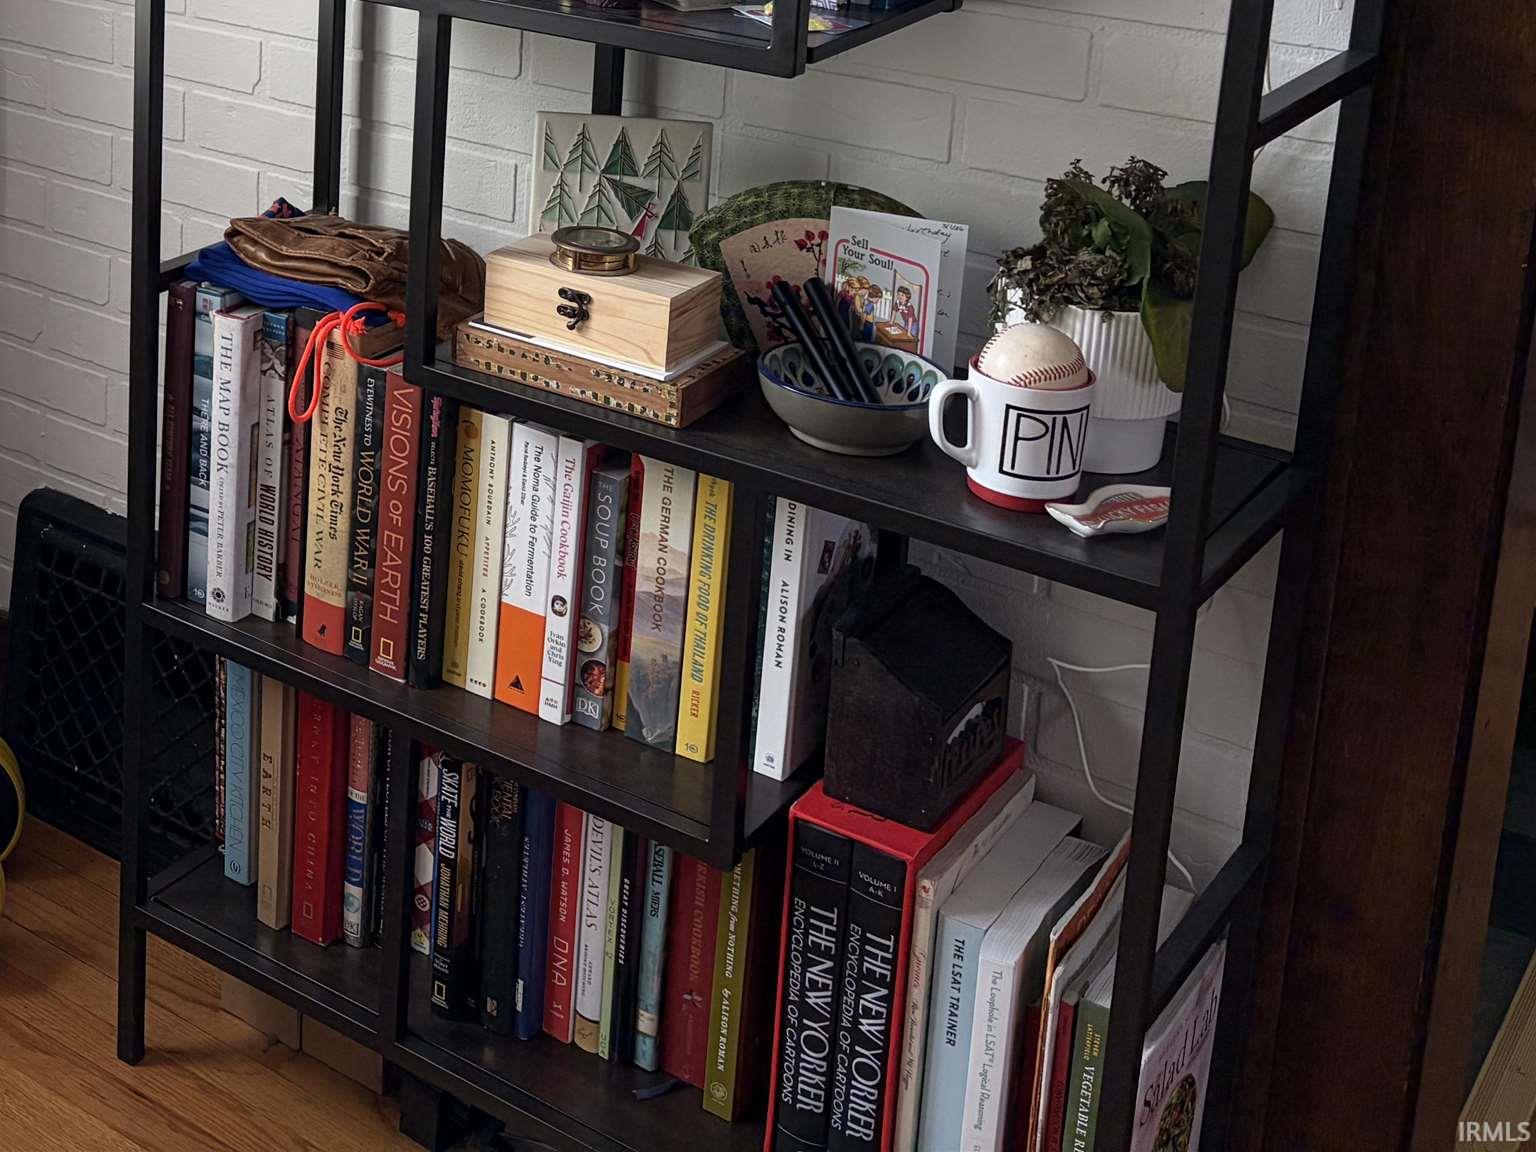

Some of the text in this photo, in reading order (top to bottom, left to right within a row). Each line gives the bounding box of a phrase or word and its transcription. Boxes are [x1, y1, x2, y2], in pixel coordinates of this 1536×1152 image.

[842, 245, 894, 272] Your Soul!
[850, 235, 870, 250] Sell
[197, 398, 210, 486] THERE AND BACK
[255, 394, 278, 582] ATLAS OF WORLD HISTORY
[327, 406, 350, 542] The New York Times
[352, 377, 376, 586] EYEWITNESS TO WORLD WAR II
[1010, 412, 1085, 476] PIN
[378, 386, 415, 625] VISIONS OF EARTH
[456, 445, 475, 557] MOMOFUKU
[524, 445, 544, 597] The Noma Guide to Fermentation
[555, 457, 576, 581] The Gaijin Cookbook
[588, 492, 613, 616] SOUP BOOK
[651, 467, 675, 633] THE GERMAN COOKBOOK
[416, 465, 438, 661] BASEBALL'S 100 GREATEST PLAYERS
[774, 502, 797, 671] DINING IN ALISON ROMAN
[261, 752, 273, 832] EARTH
[345, 805, 366, 883] WORLD
[585, 815, 606, 931] DEVIL'S ATLAS
[780, 898, 807, 1105] ENCYCLOPEDIA OF CARTOONS
[795, 906, 838, 1114] THE NEW YORKER
[830, 923, 862, 1130] ENCYCLOPEDIA OF CARTOONS
[945, 938, 966, 1048] THE LSAT TRAINER
[985, 986, 1002, 1023] Loophole
[985, 1023, 995, 1033] in
[991, 969, 1004, 986] The
[845, 932, 895, 1143] THE NEW YORKER
[978, 1064, 994, 1093] Logical
[974, 1093, 990, 1131] Reasoning
[1074, 1064, 1096, 1137] VEGETABLE
